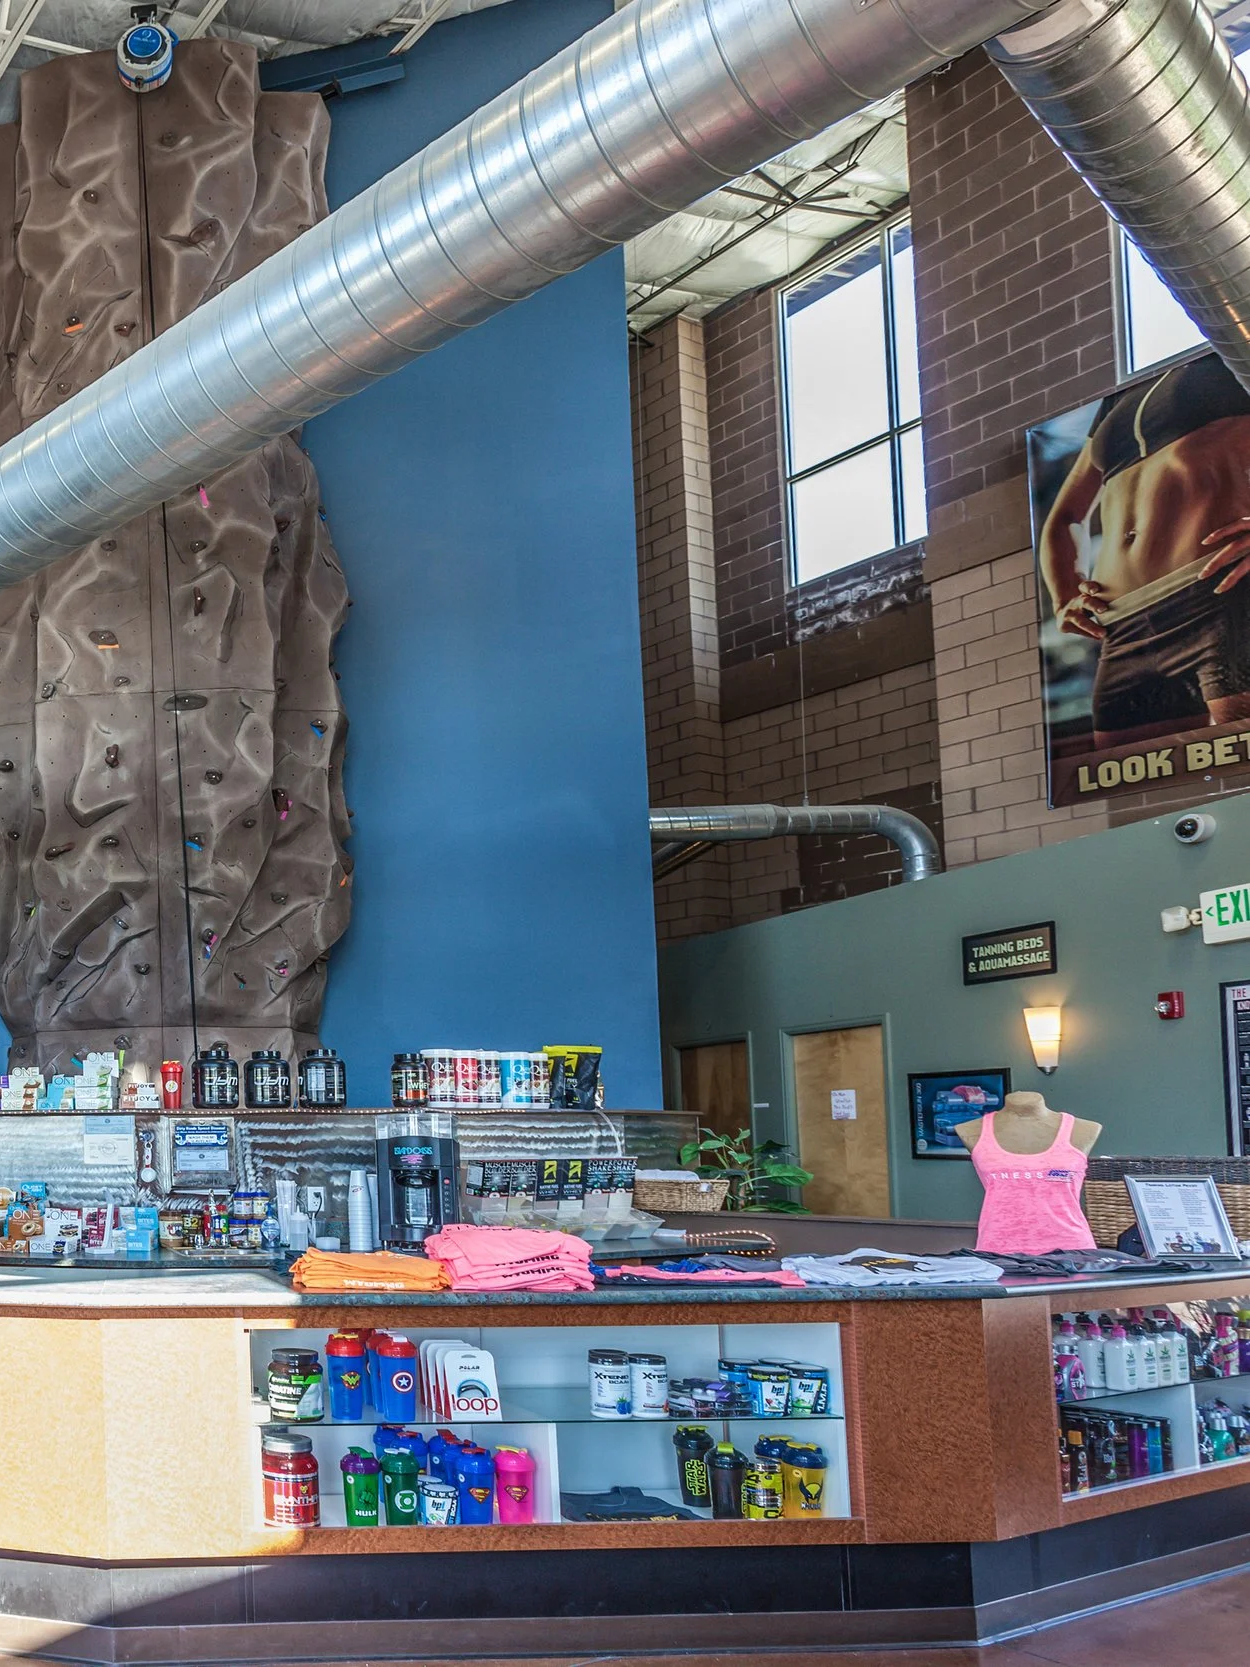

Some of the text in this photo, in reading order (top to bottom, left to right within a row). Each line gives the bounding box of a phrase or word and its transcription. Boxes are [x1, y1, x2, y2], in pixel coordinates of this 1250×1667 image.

[1078, 748, 1174, 793] LOOK
[972, 936, 1044, 958] TANNING BEDS
[968, 950, 1050, 973] & AQUAMASSAGE
[1231, 987, 1247, 998] THE
[87, 1052, 114, 1062] ONE
[12, 1067, 40, 1077] ONE
[13, 1209, 41, 1220] ONE
[50, 1211, 78, 1220] ONE
[31, 1242, 50, 1250] ONE
[594, 1371, 630, 1380] XTEND
[451, 1393, 499, 1416] loop
[686, 1461, 696, 1494] STAR
[695, 1460, 706, 1495] WARS
[355, 1509, 377, 1517] HULK
